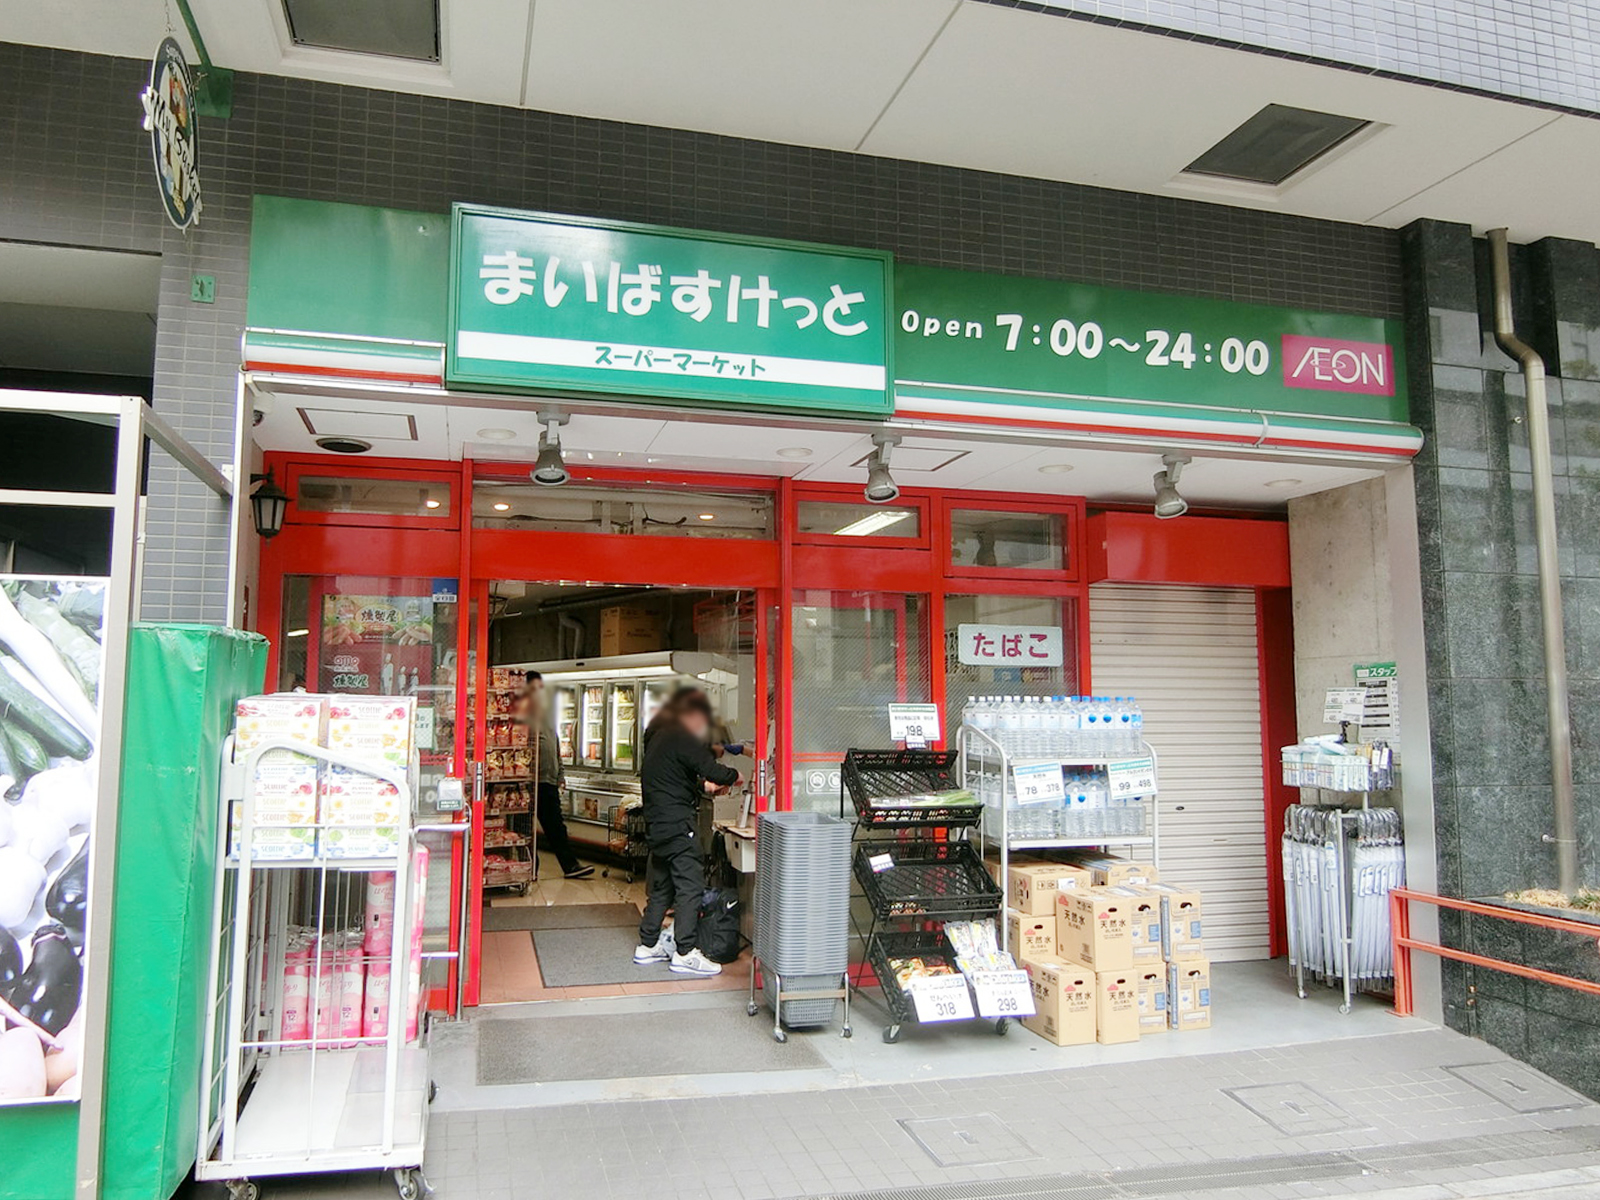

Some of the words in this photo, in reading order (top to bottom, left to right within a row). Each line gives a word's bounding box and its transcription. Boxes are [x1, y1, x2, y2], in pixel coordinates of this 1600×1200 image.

[479, 251, 869, 337] まいばすけっと
[900, 309, 983, 339] Open
[594, 346, 766, 377] スーパーマーケット
[973, 632, 1049, 658] たばこ
[1370, 667, 1397, 677] スタッフ
[906, 725, 923, 736] 198
[1025, 786, 1038, 795] 78
[1046, 783, 1061, 793] 378
[1118, 782, 1131, 791] 99
[1064, 909, 1086, 926] 天然水
[1100, 919, 1127, 929] 天然水
[1026, 936, 1052, 945] 天然水
[1066, 991, 1092, 1001] 天然水
[1109, 991, 1134, 1001] 天然水
[935, 1001, 957, 1016] 318
[997, 997, 1018, 1012] 298
